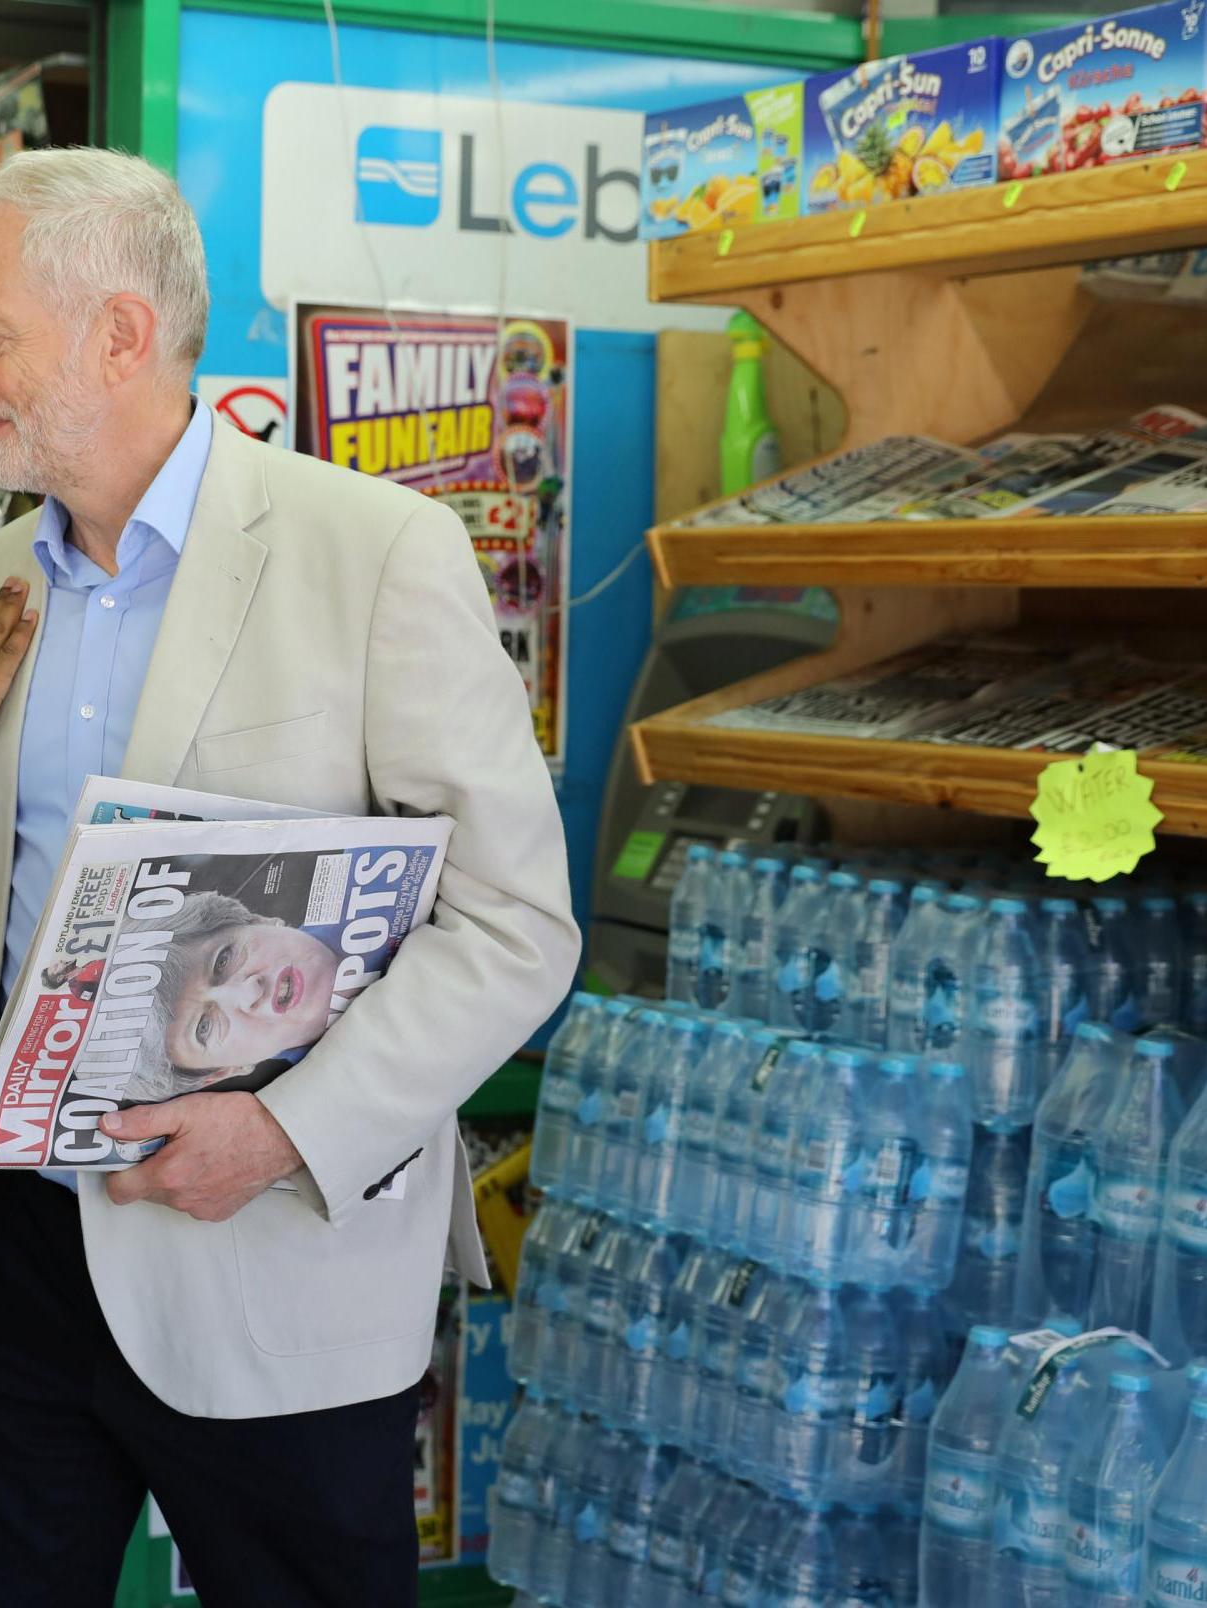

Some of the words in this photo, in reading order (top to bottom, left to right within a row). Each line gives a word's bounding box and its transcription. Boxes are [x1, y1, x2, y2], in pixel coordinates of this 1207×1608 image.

[1037, 21, 1167, 83] Capri-Sonne
[841, 63, 942, 139] Capri-Sun
[459, 132, 641, 243] Leb
[325, 342, 496, 420] FAMILY
[330, 404, 493, 474] FUNFAIR
[55, 911, 75, 953] SCOTLAND
[71, 867, 89, 905] ENGLAND
[75, 867, 105, 919] FREE
[92, 888, 108, 916] shop
[101, 866, 115, 886] bet
[106, 868, 127, 911] Ladbrokes
[65, 920, 115, 954] £1
[53, 930, 172, 1163] COALITION
[127, 859, 192, 920] OF
[3, 1060, 31, 1105] DAILY
